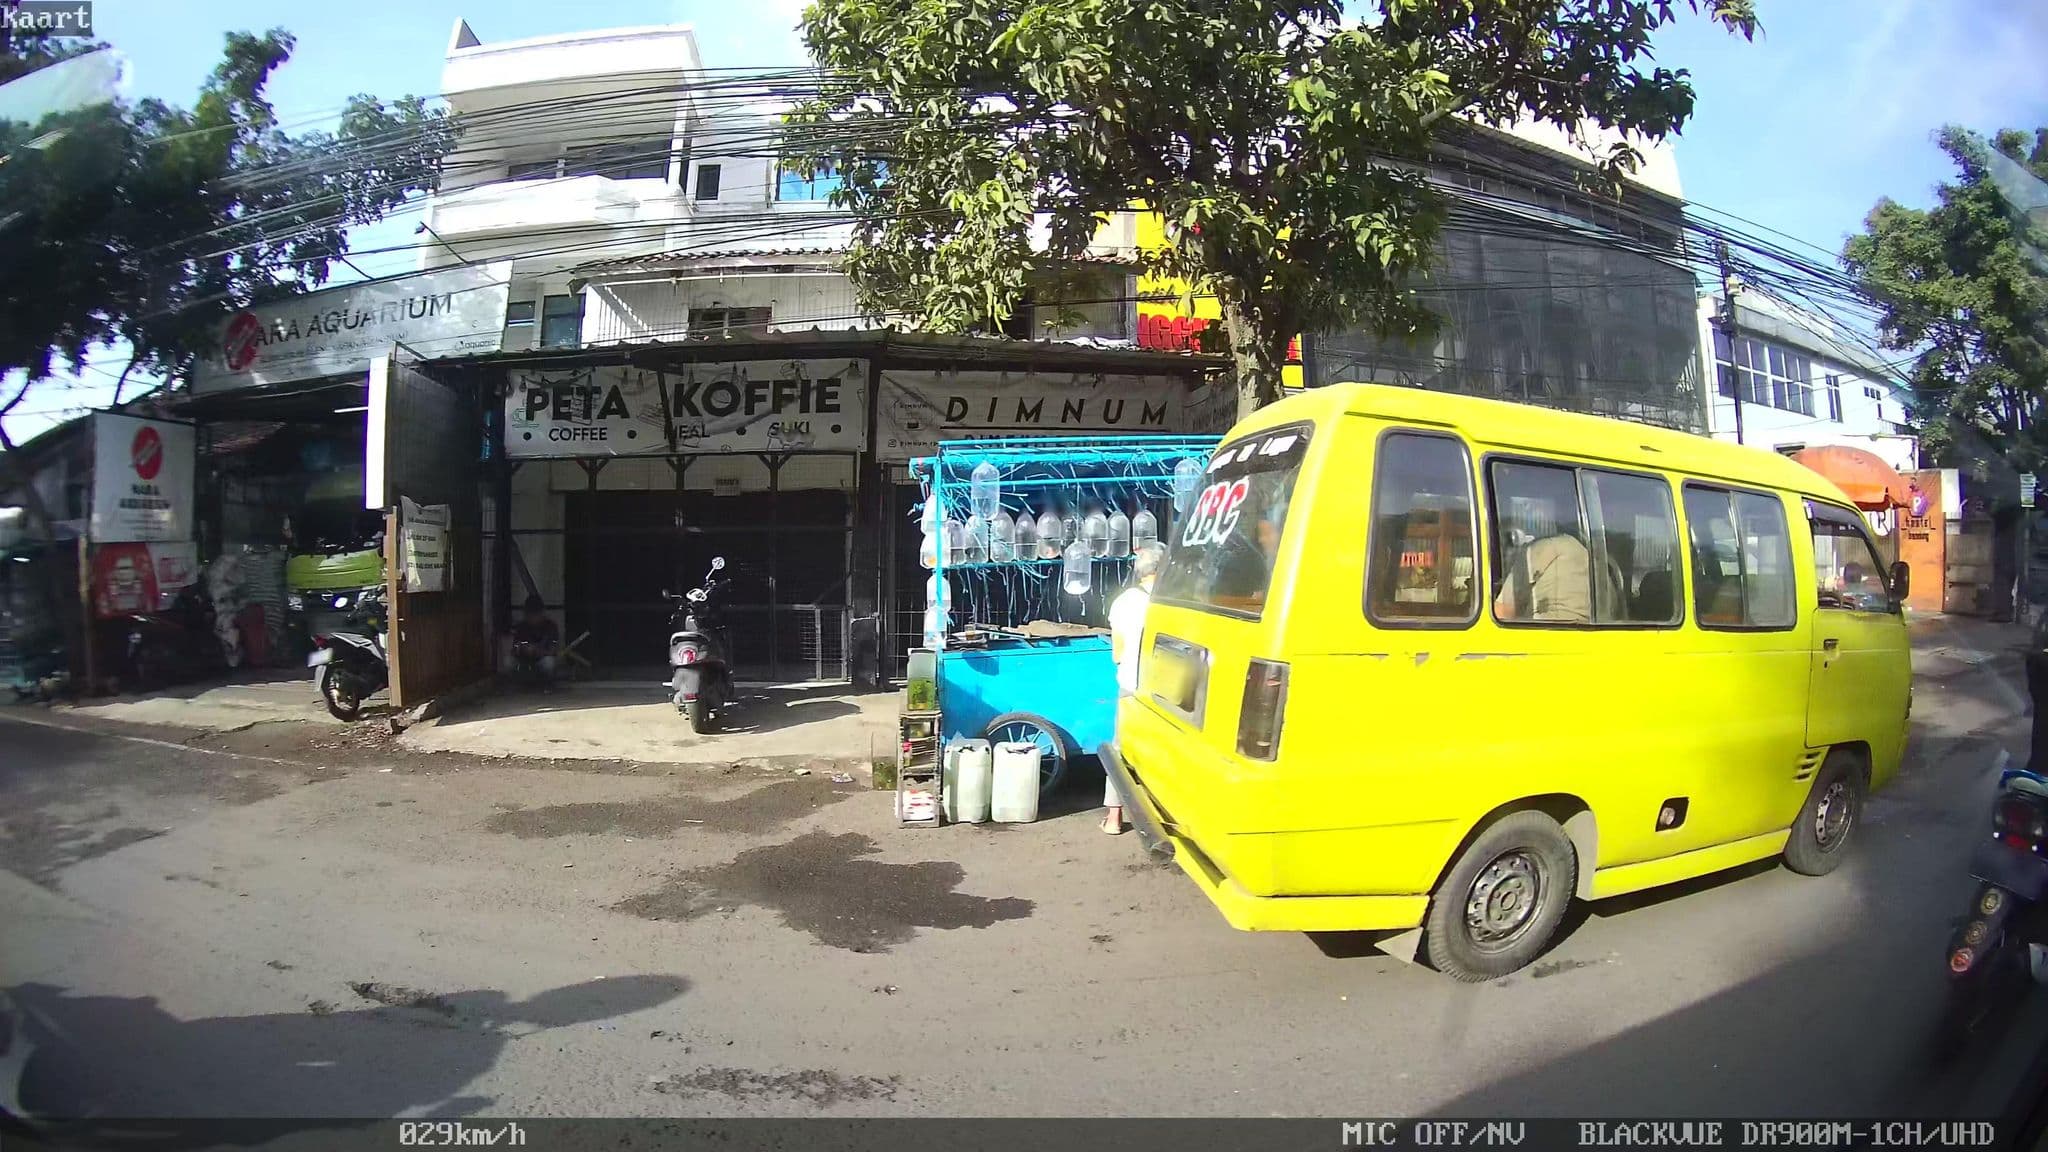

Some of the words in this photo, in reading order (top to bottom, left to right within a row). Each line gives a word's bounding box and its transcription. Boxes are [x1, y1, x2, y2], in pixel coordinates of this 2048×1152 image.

[306, 294, 451, 339] AQUARIUM
[525, 384, 631, 421] PETA
[673, 378, 842, 418] KOFFIE
[945, 396, 1169, 425] DIMNUM
[548, 427, 608, 442] COFFEE
